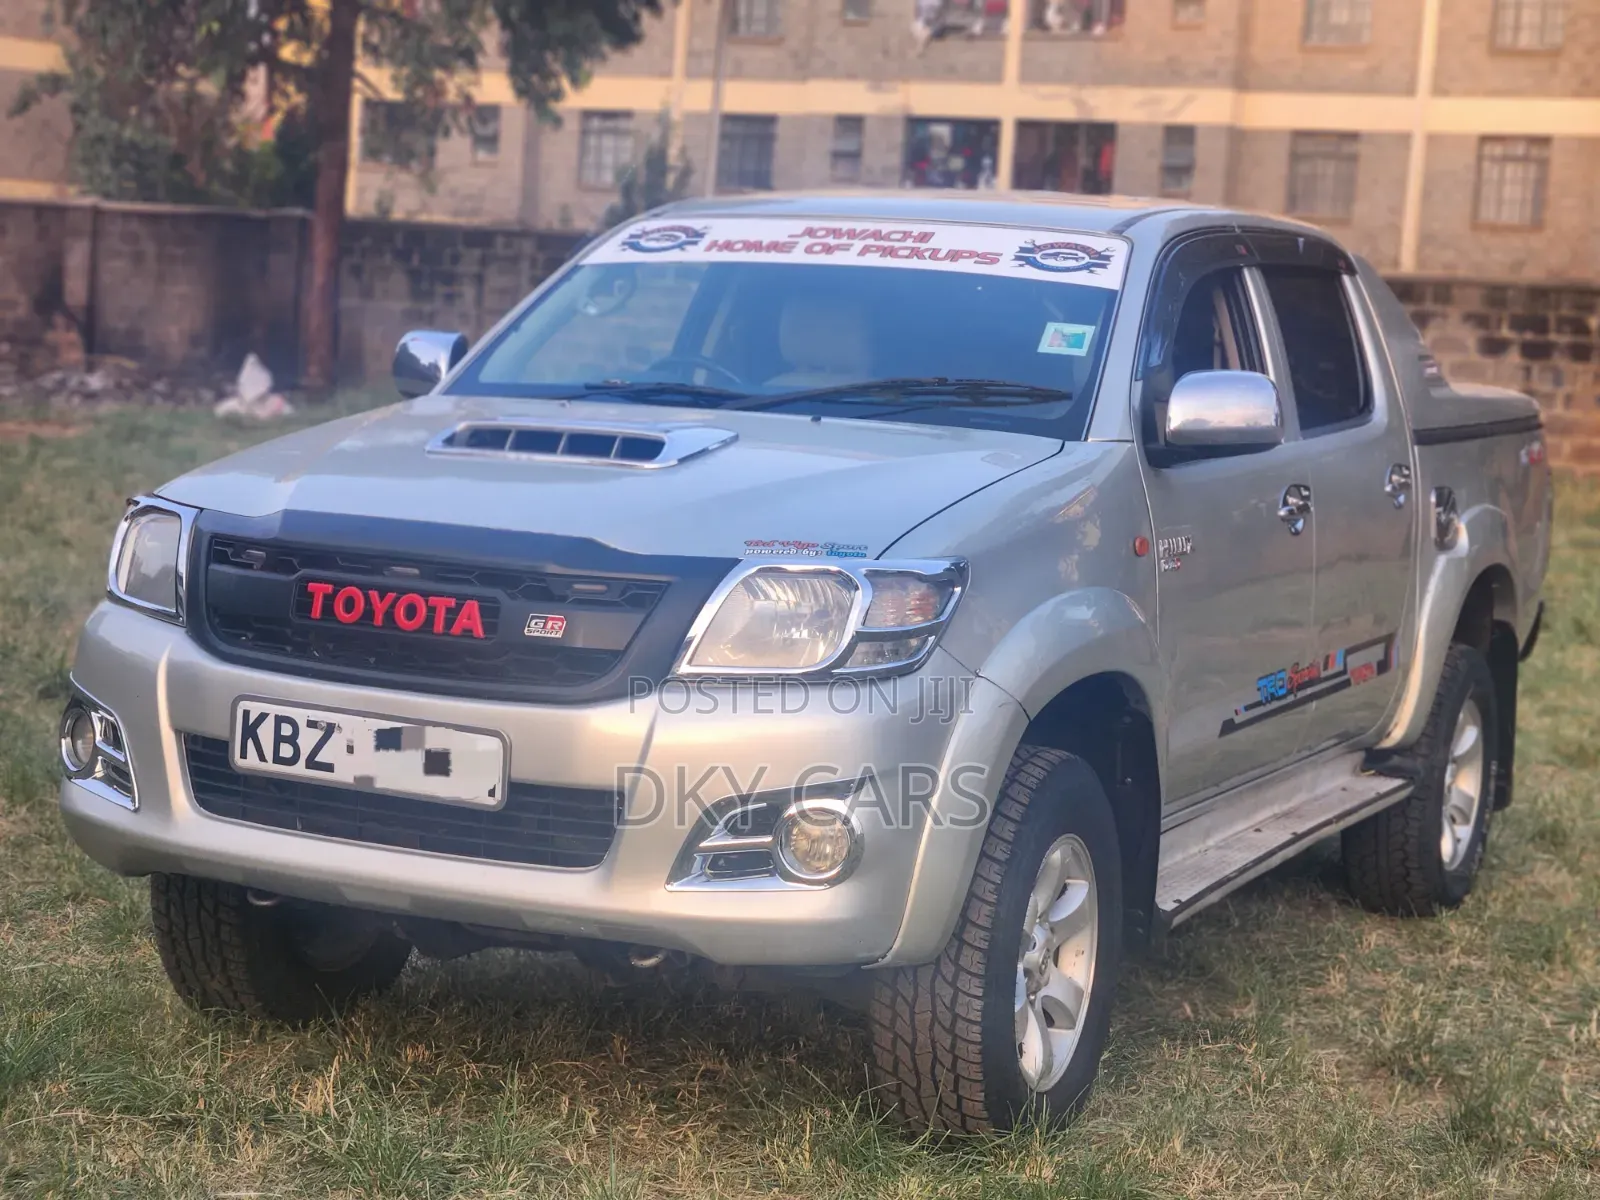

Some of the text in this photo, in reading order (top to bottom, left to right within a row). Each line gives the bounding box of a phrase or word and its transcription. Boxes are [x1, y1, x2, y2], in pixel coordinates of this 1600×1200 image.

[788, 226, 935, 244] JOWACHI
[704, 239, 1003, 266] HOME OF PICKUPS
[307, 582, 485, 639] TOYOTA
[526, 628, 561, 636] SPORT
[530, 619, 563, 630] GR
[239, 709, 336, 774] KBZ
